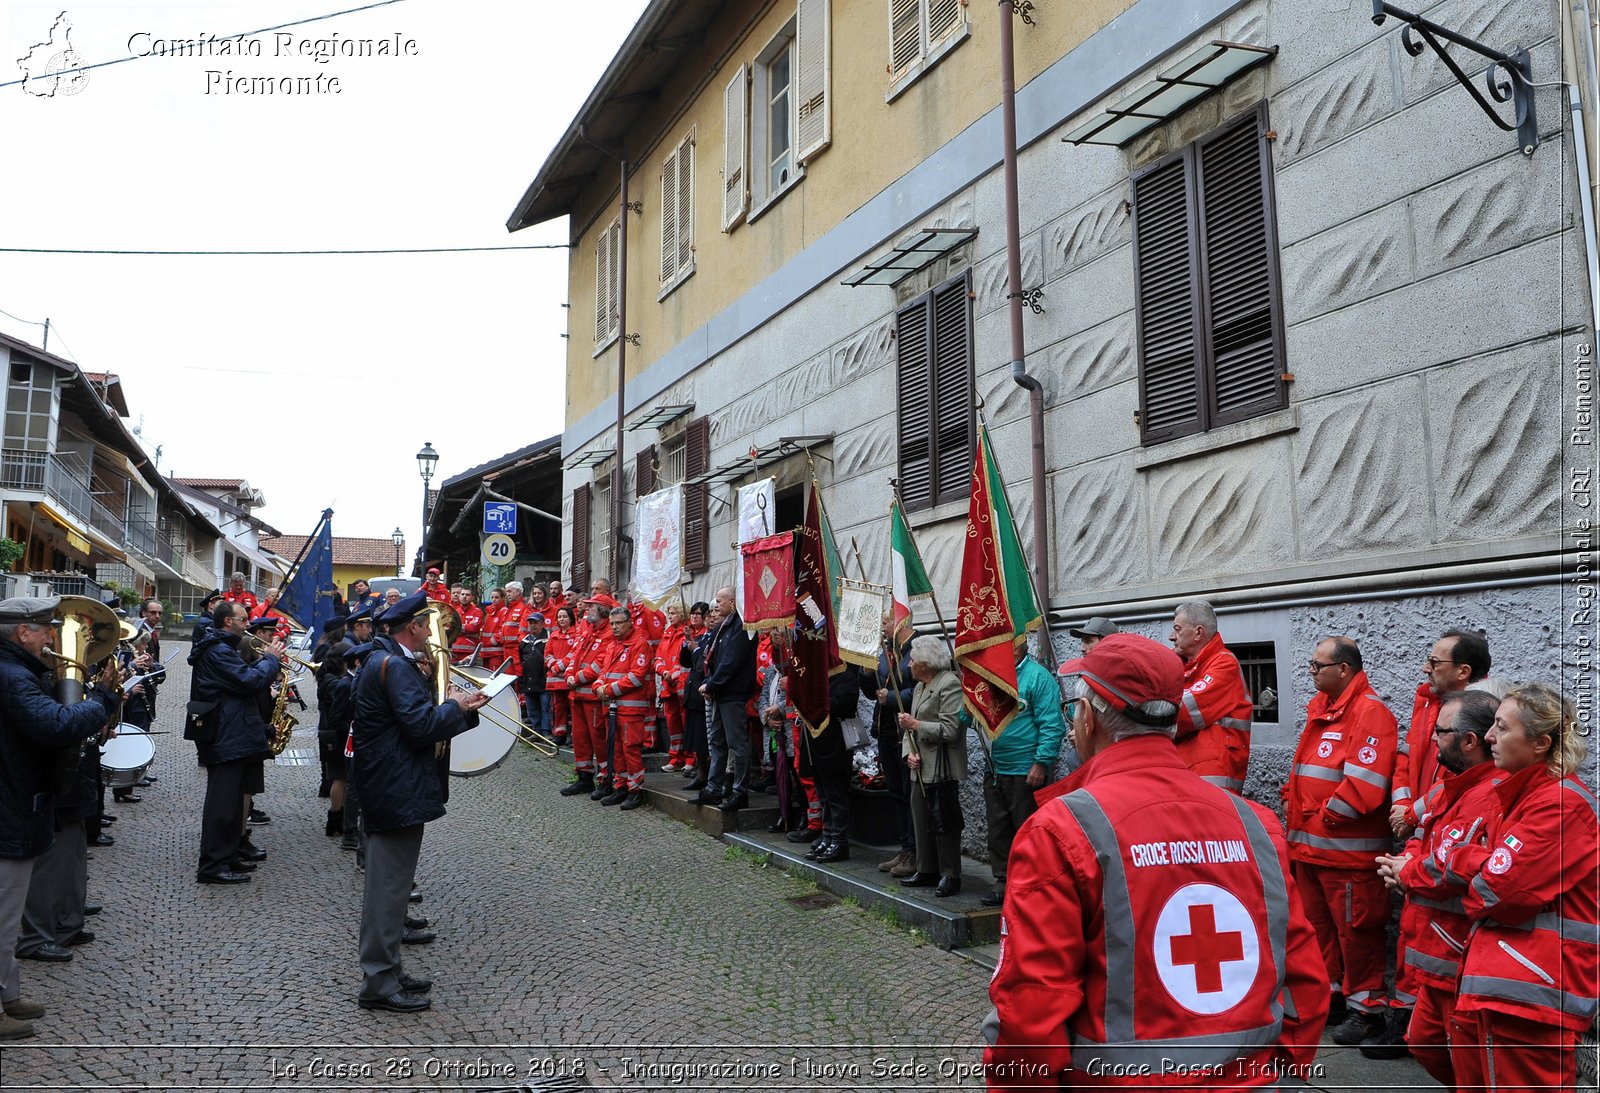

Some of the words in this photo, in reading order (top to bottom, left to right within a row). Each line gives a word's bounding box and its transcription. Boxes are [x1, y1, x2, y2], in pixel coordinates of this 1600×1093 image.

[491, 541, 509, 557] 20
[1130, 842, 1169, 868] CROCE
[1169, 840, 1206, 864] ROSSA
[1205, 840, 1249, 863] ITALIANA
